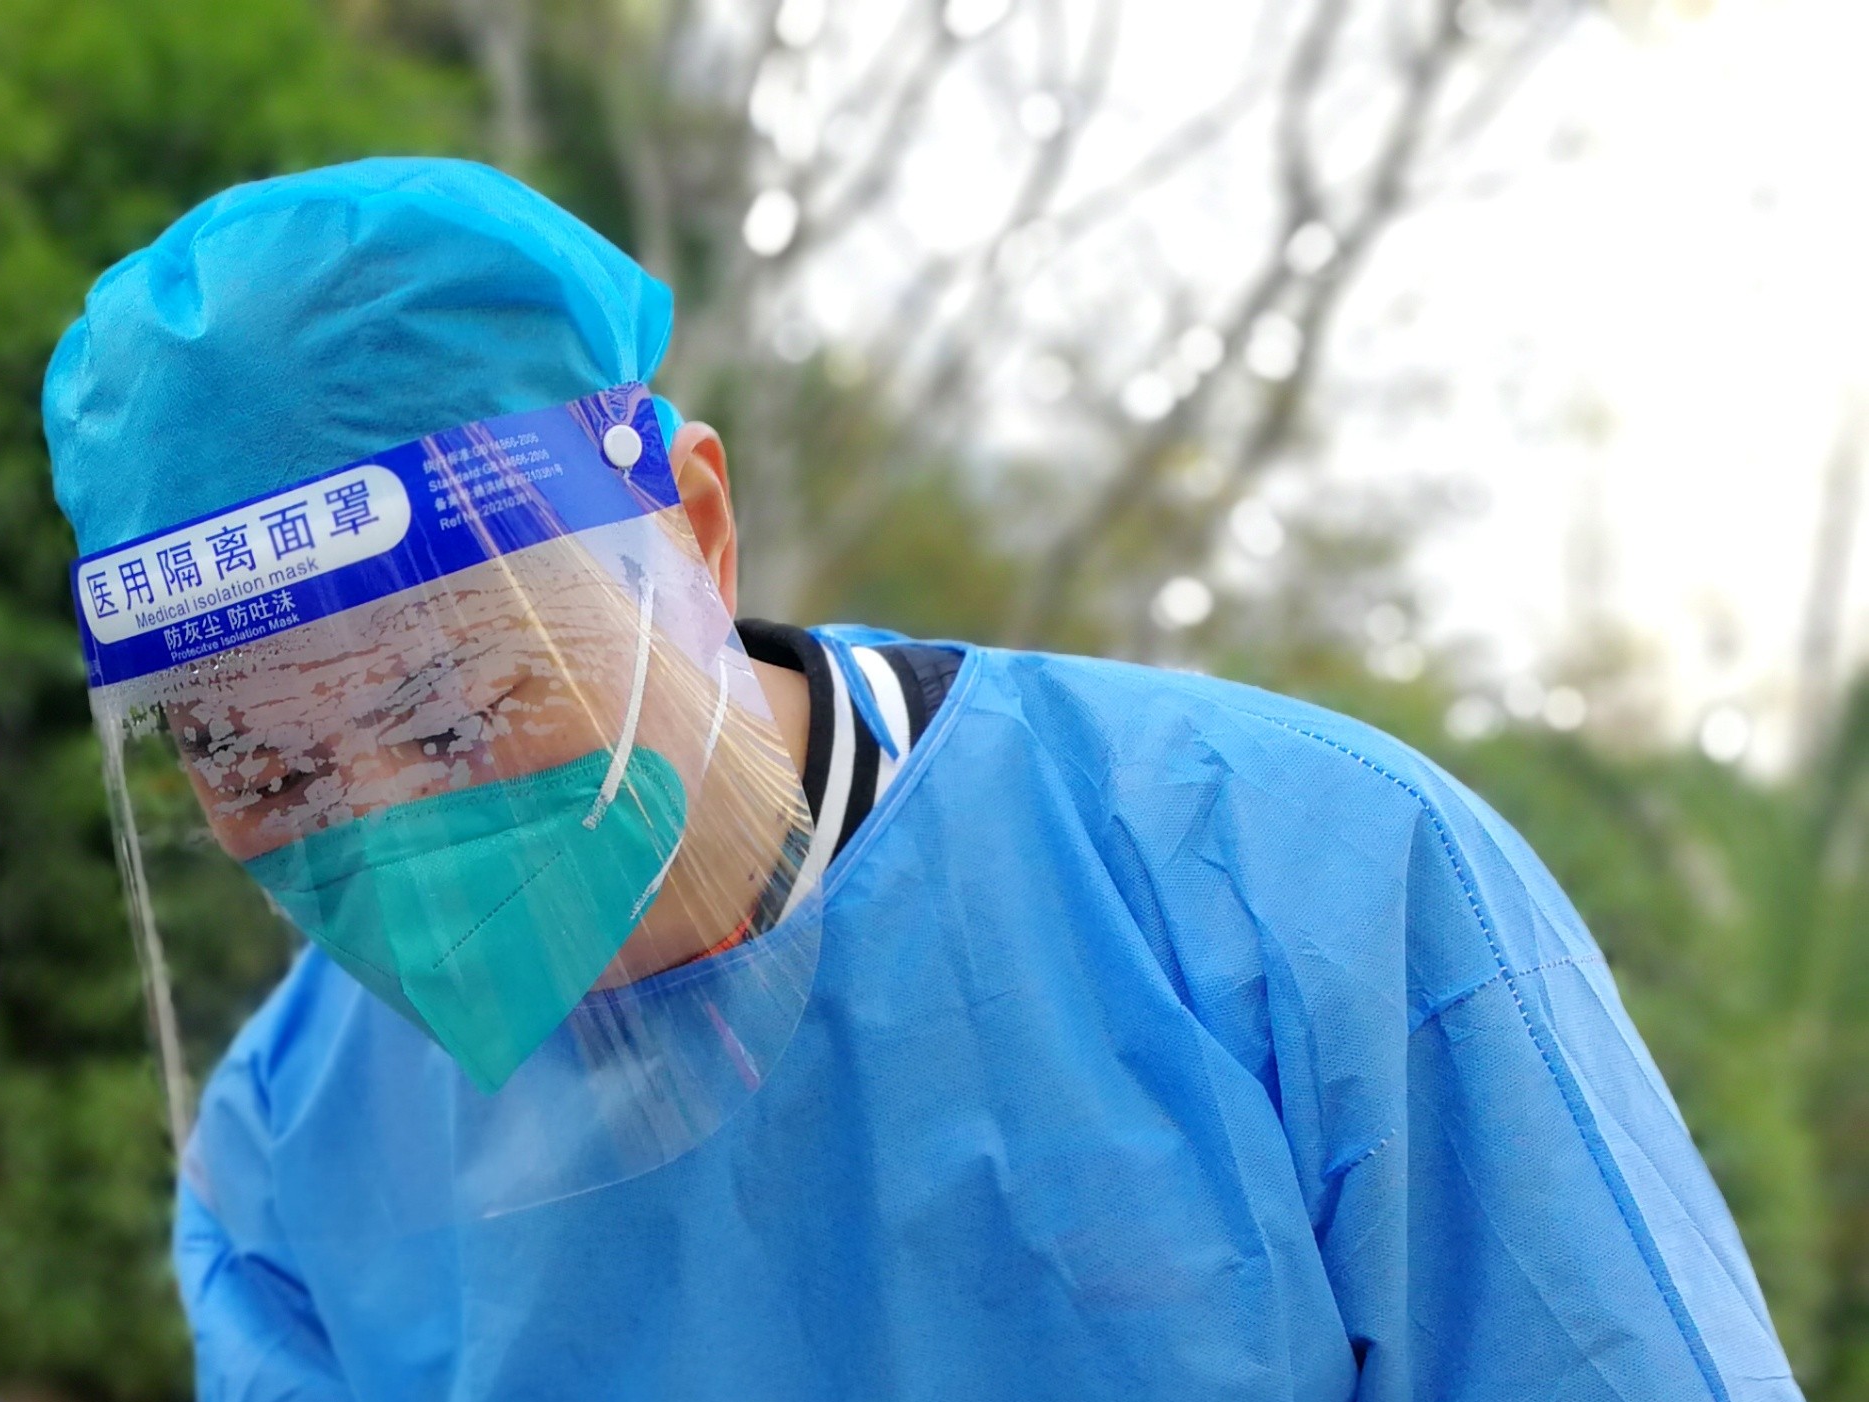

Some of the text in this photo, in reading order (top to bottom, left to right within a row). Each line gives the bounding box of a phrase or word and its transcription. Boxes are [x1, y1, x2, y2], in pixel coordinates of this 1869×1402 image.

[86, 480, 379, 620] 医用隔离面罩
[135, 556, 320, 630] Medical isolation mask
[163, 613, 224, 650] 防灰尘
[221, 623, 266, 651] Isolation
[268, 612, 300, 631] Mask
